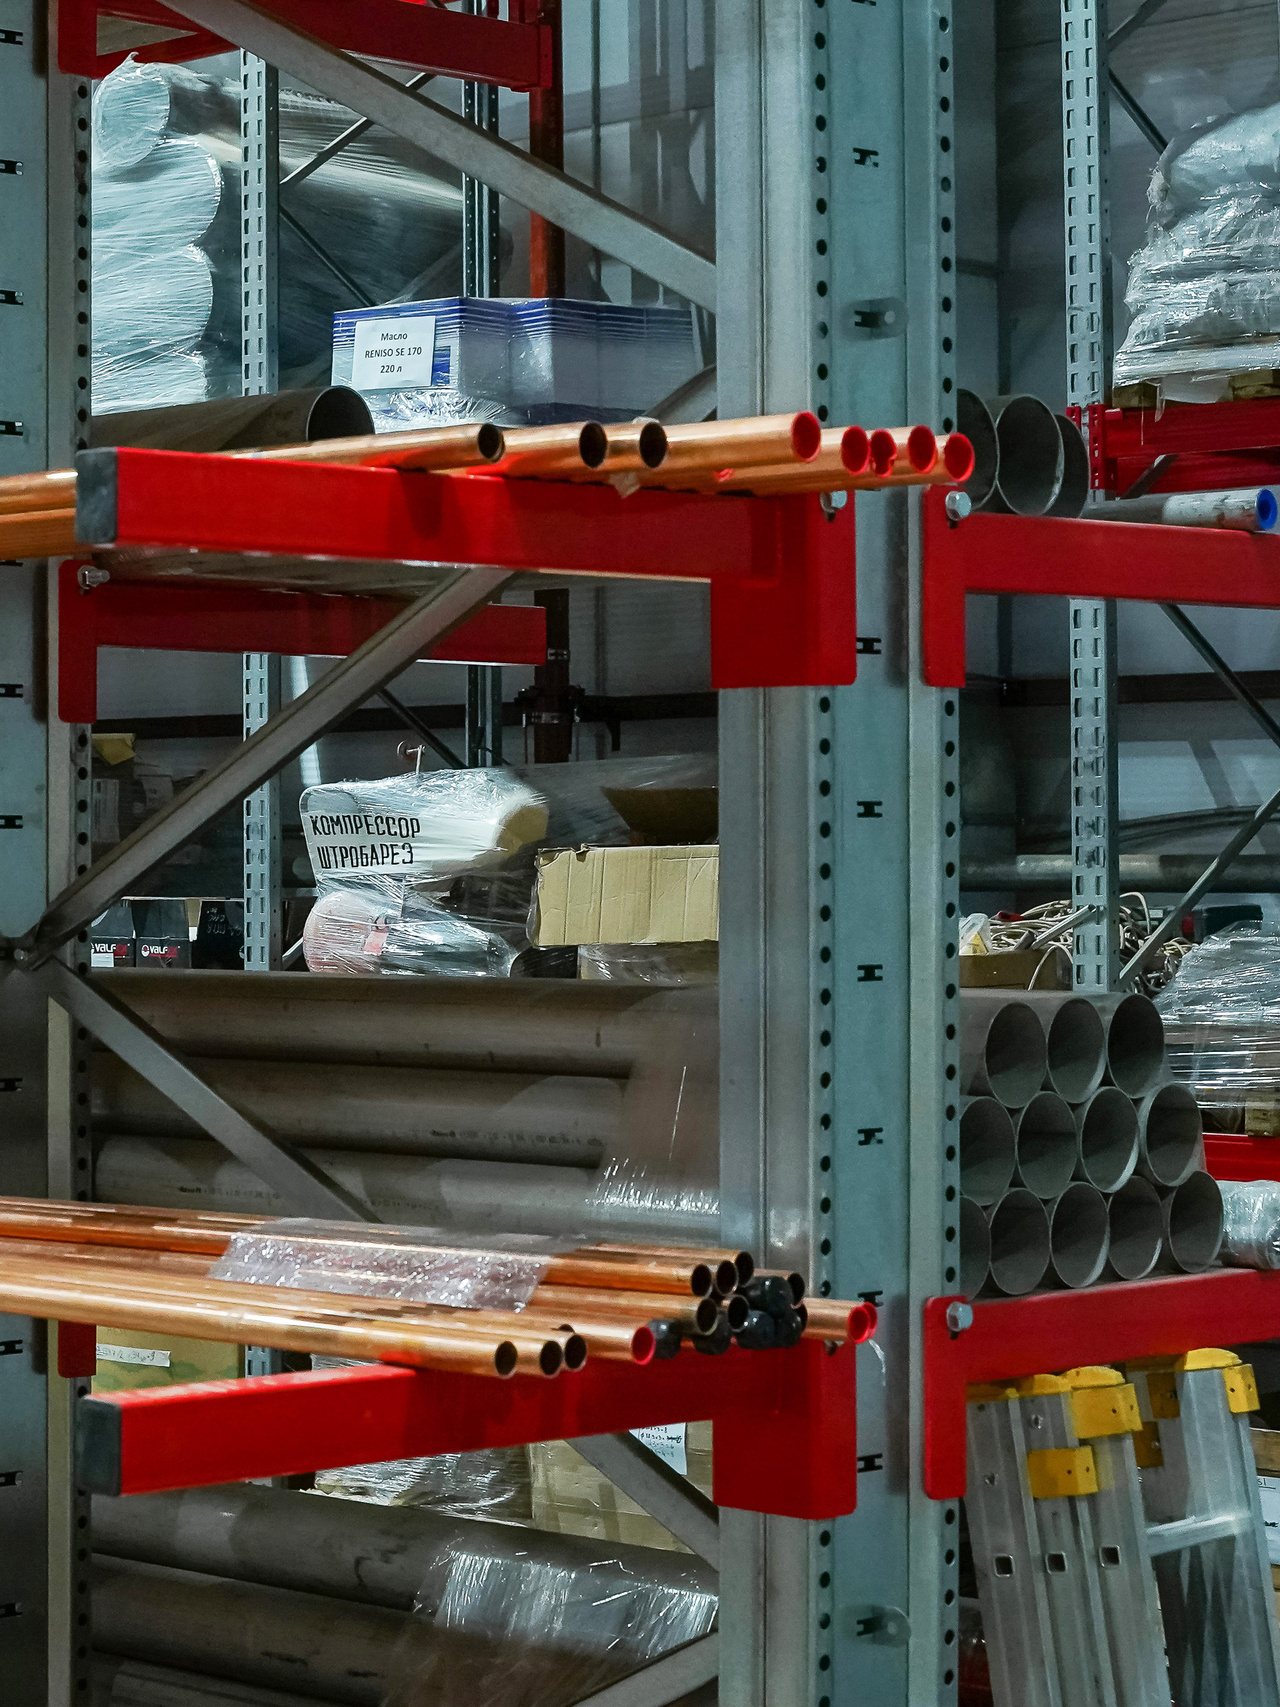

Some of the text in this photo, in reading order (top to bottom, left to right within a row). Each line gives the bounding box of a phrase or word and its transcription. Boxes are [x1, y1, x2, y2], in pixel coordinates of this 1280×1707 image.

[380, 332, 408, 341] Масло
[364, 346, 422, 358] RENISO SE 170
[380, 364, 402, 373] 220 л
[310, 814, 421, 838] КОМПРЕССОР
[317, 842, 414, 869] ШТРОБАРЕЗ
